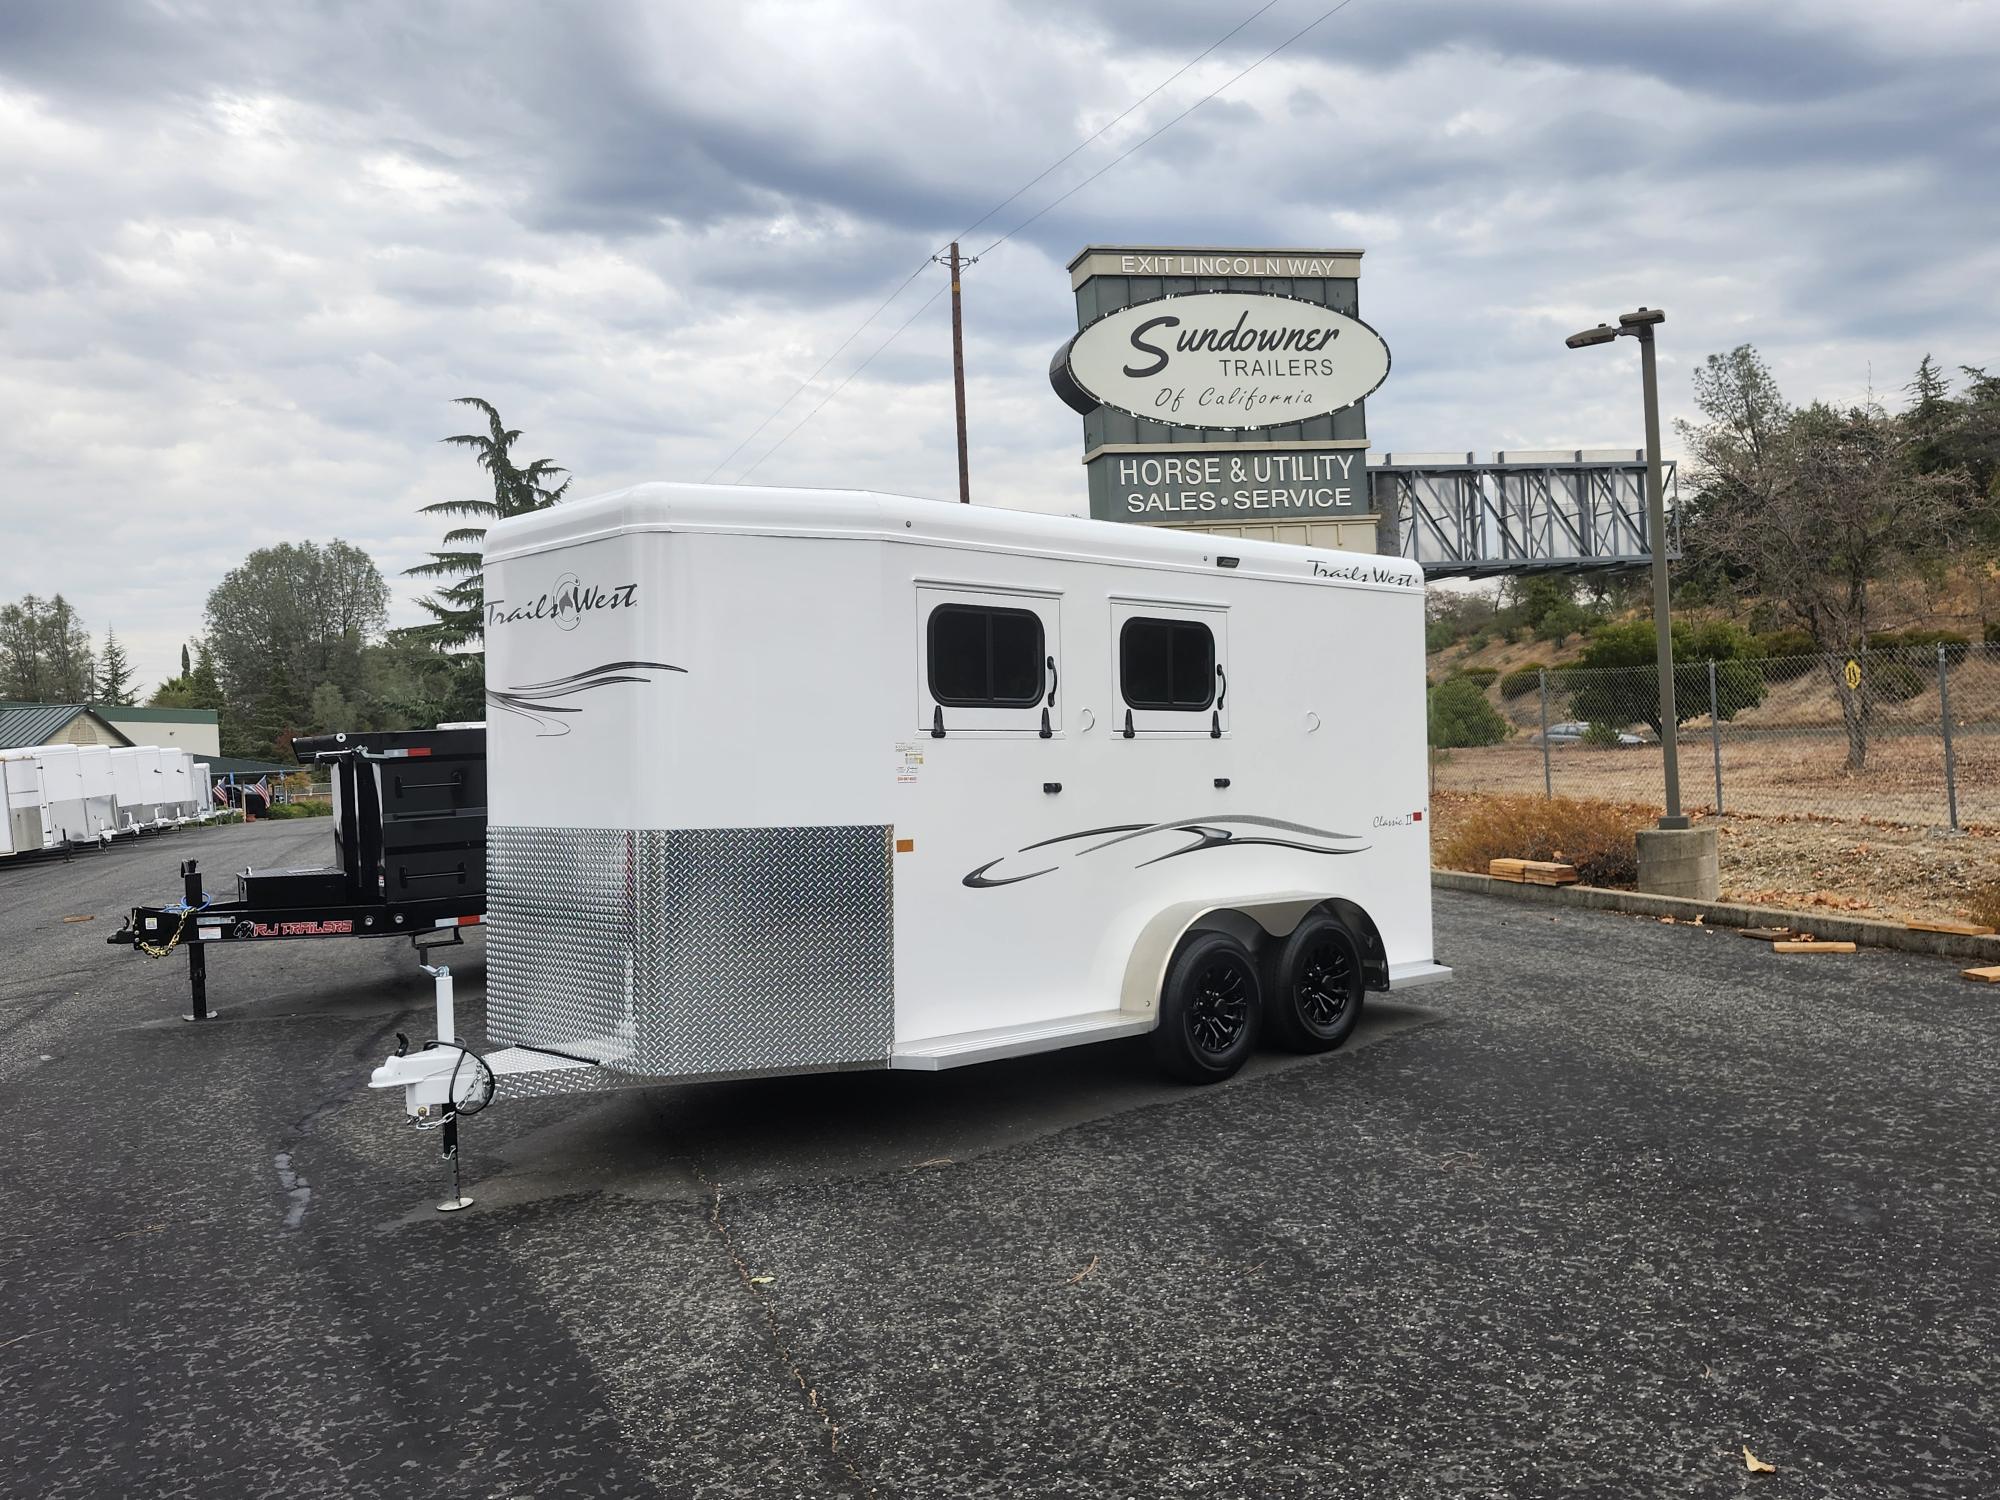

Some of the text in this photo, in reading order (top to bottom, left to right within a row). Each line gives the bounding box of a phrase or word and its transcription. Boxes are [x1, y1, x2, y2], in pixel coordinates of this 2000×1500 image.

[1121, 256, 1335, 276] EXIT LINCOLN WAY
[1123, 310, 1339, 378] Sundowner
[1219, 359, 1334, 377] TRAILERS
[1155, 387, 1312, 411] Of California
[1119, 455, 1354, 485] HORSE & UTILITY
[1306, 560, 1413, 587] Trails West
[485, 583, 638, 627] Trails West
[1372, 815, 1403, 828] Classic
[280, 920, 353, 935] TRAILERS
